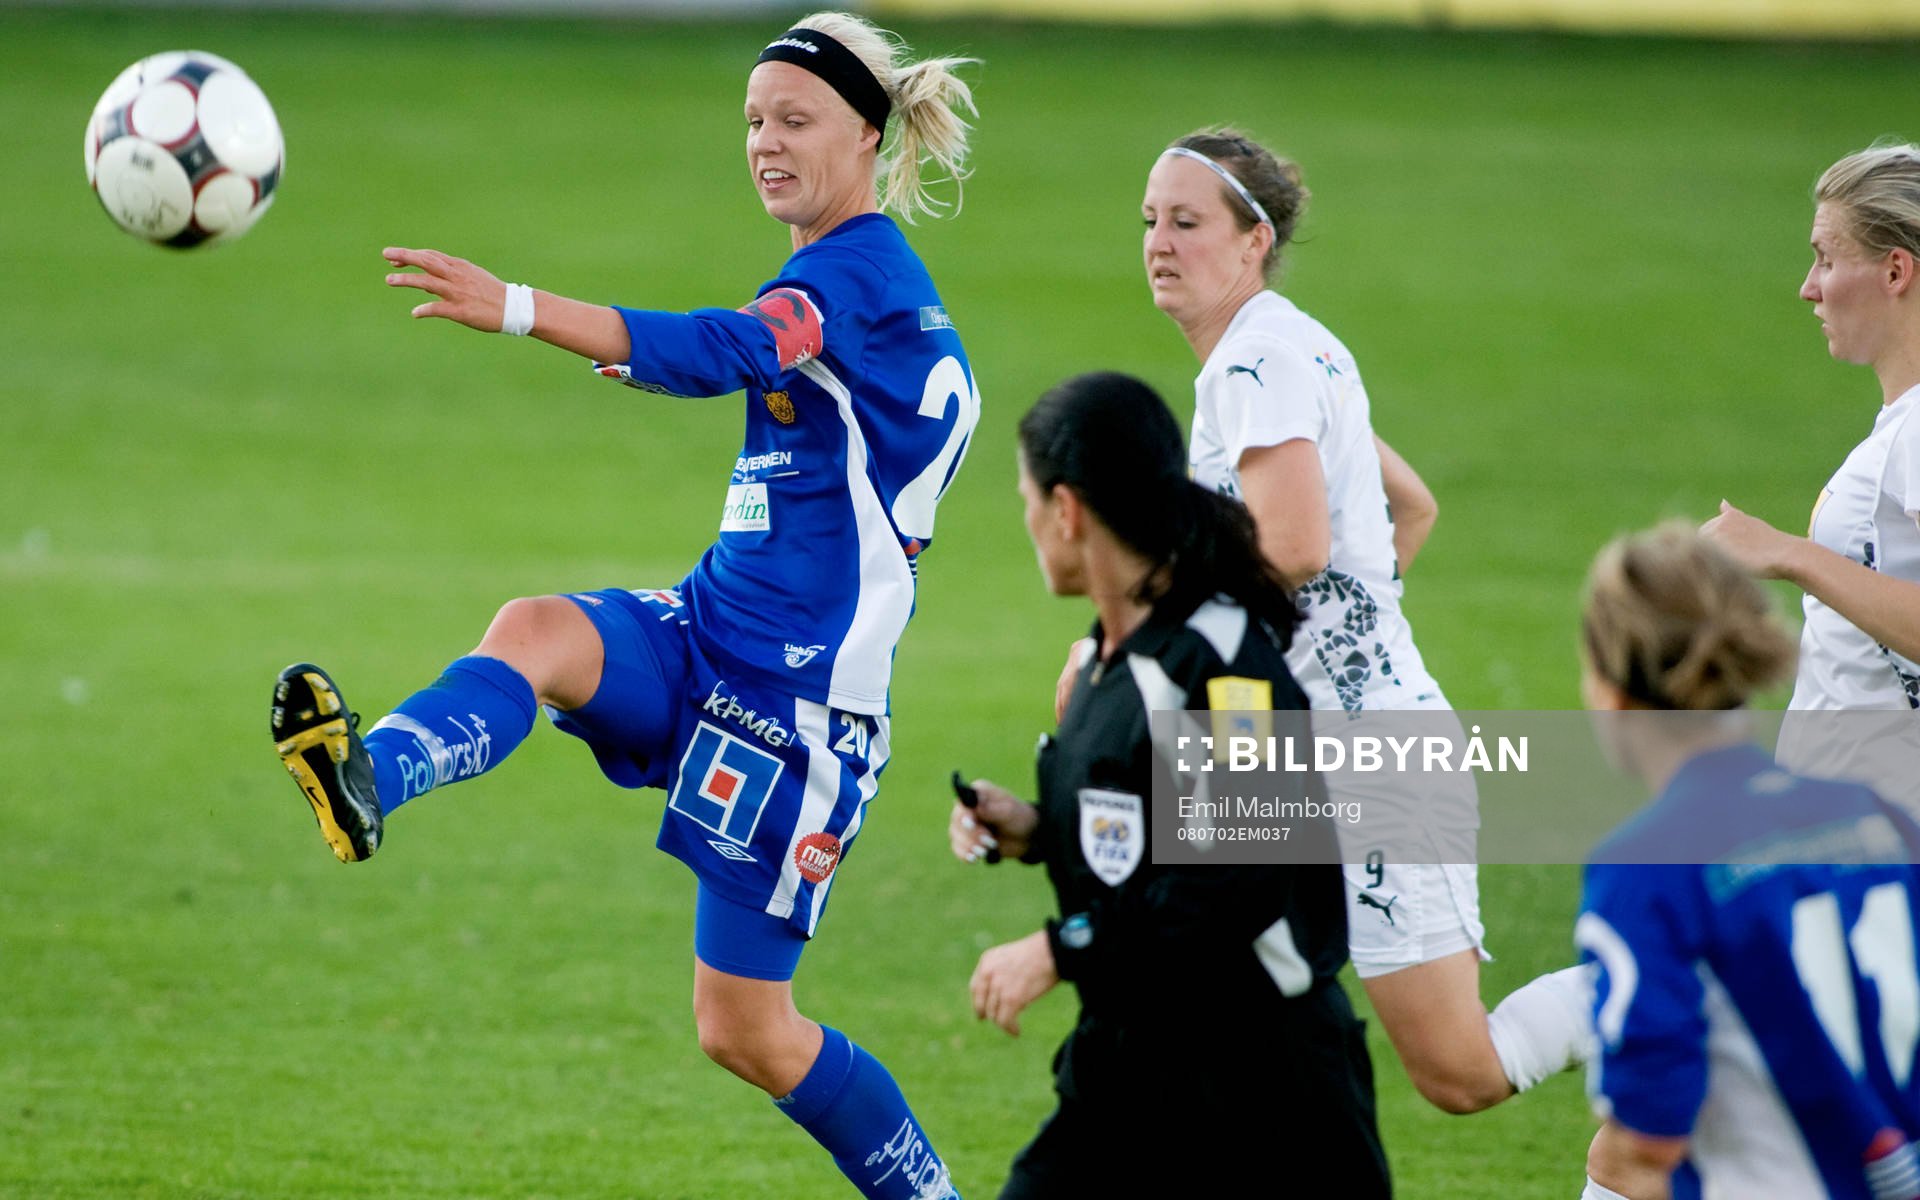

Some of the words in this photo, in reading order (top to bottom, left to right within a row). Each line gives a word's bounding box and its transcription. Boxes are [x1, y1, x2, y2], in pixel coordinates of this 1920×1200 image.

[703, 692, 788, 747] KPMG
[833, 713, 868, 759] 20
[801, 845, 836, 870] mix
[1366, 850, 1384, 889] 9
